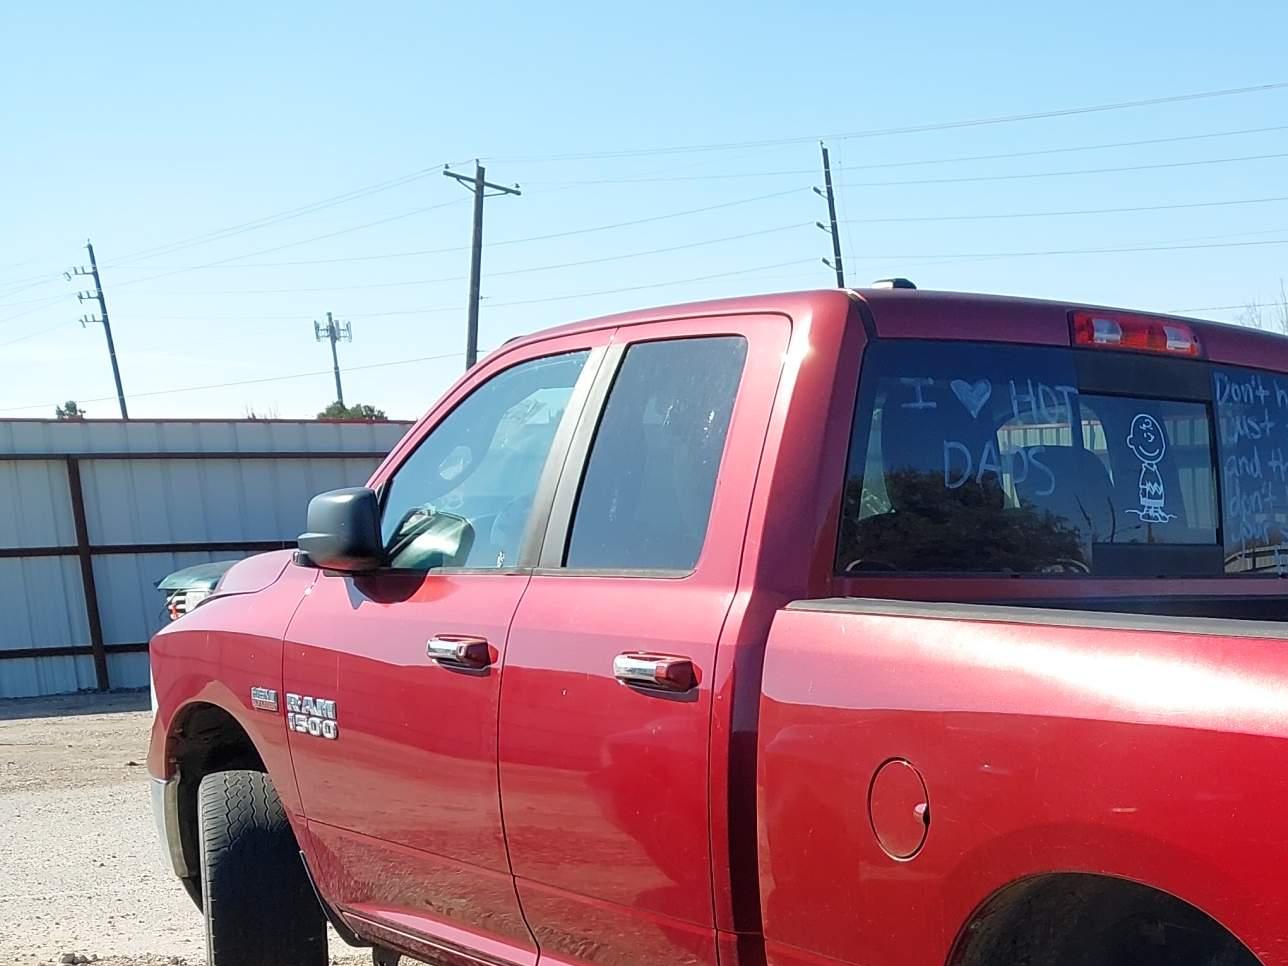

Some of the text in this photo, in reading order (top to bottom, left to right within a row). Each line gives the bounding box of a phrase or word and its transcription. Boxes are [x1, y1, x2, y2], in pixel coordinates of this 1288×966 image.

[900, 377, 1079, 424] I HOT
[1213, 371, 1270, 405] Don't
[943, 440, 1056, 496] DADS
[286, 693, 337, 719] RAM
[287, 712, 339, 739] 1500
